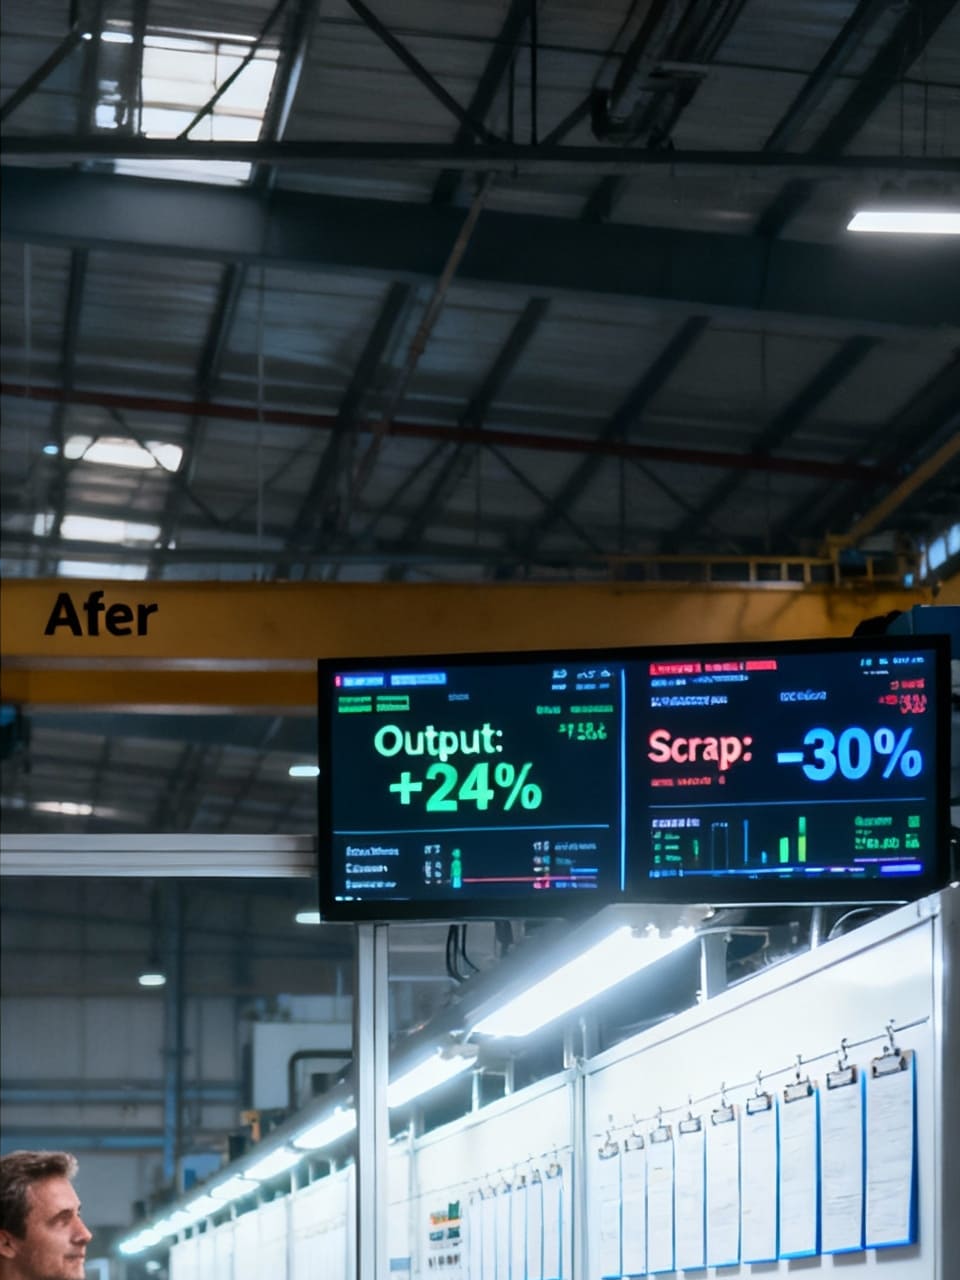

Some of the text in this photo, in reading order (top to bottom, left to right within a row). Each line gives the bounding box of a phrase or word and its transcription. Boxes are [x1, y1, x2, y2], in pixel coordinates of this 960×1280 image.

[44, 590, 159, 637] Afer
[373, 722, 504, 762] Output:
[648, 726, 923, 781] Scrap: -30%
[388, 762, 543, 813] +24%
